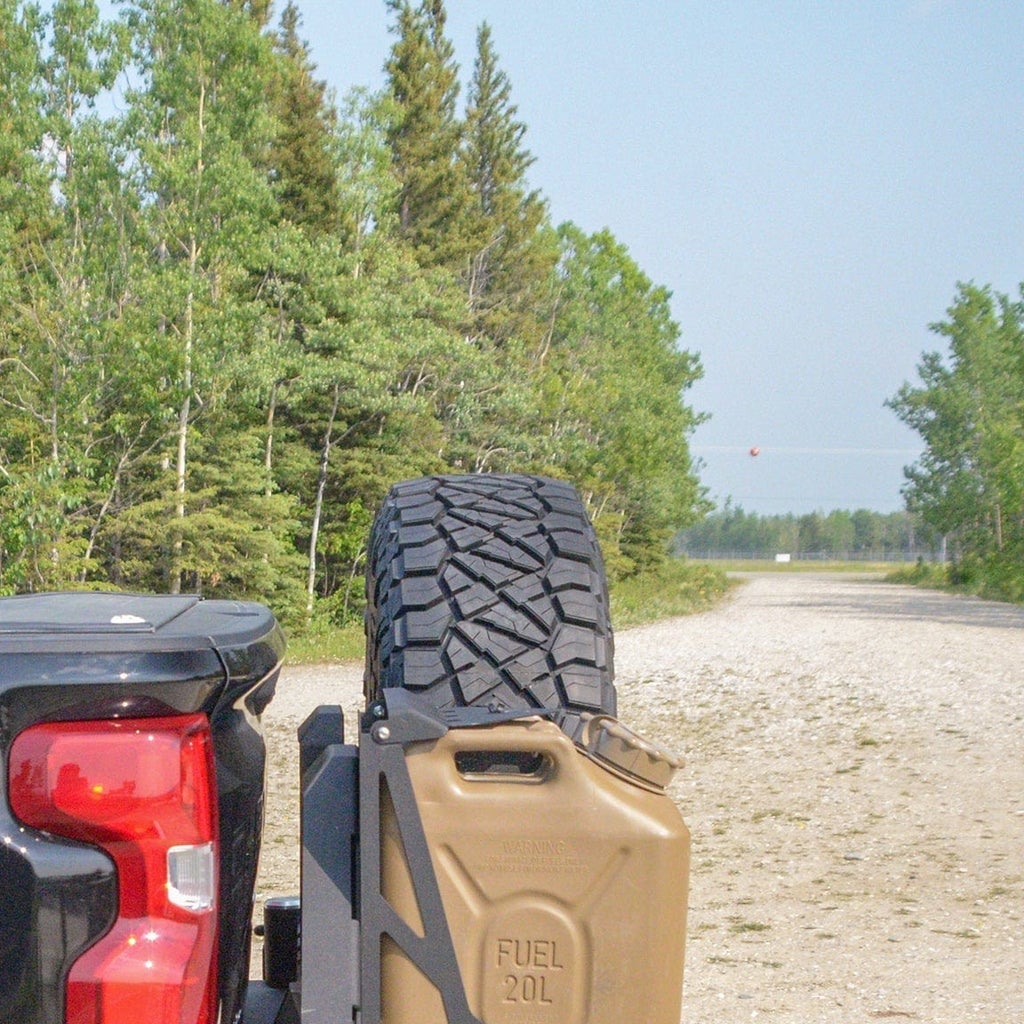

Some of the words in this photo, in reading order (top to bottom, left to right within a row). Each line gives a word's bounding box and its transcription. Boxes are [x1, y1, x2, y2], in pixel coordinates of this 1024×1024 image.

[502, 839, 566, 856] WARNING
[497, 938, 564, 969] FUEL
[503, 974, 553, 1004] 20L
